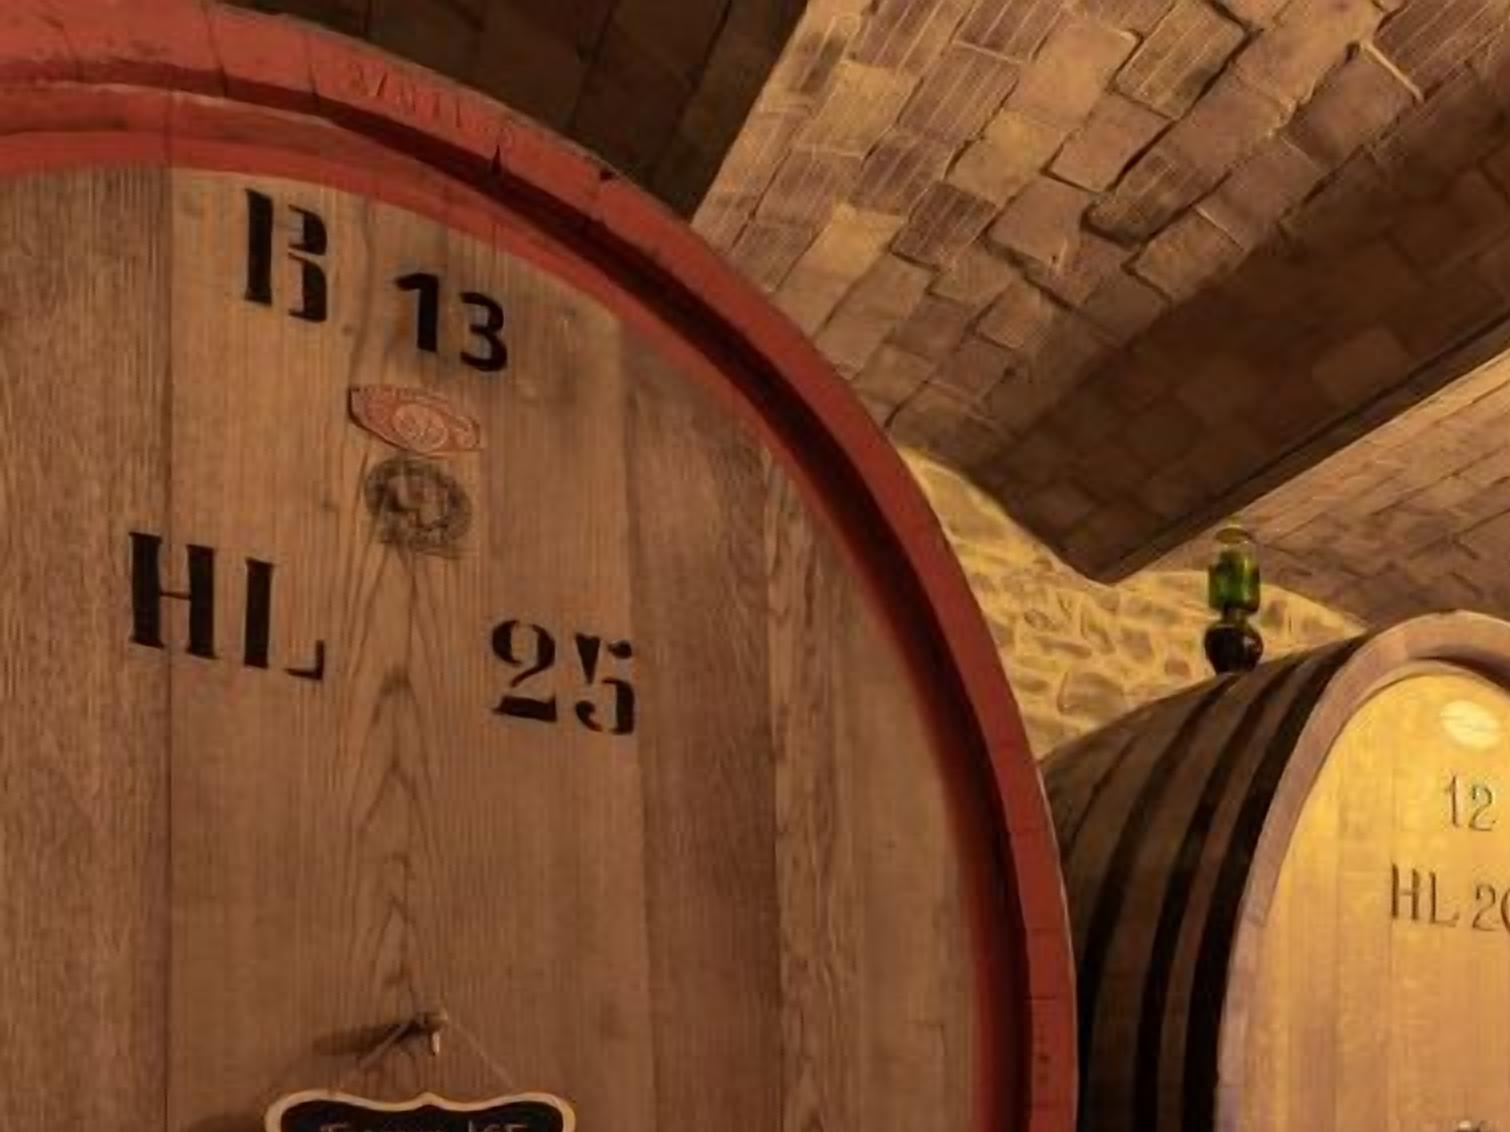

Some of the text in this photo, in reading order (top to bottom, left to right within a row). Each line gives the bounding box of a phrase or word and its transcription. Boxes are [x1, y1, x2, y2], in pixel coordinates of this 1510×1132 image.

[243, 187, 509, 373] B 13
[128, 530, 637, 736] HL 25
[1445, 774, 1497, 832] 12
[1390, 863, 1460, 928] HL
